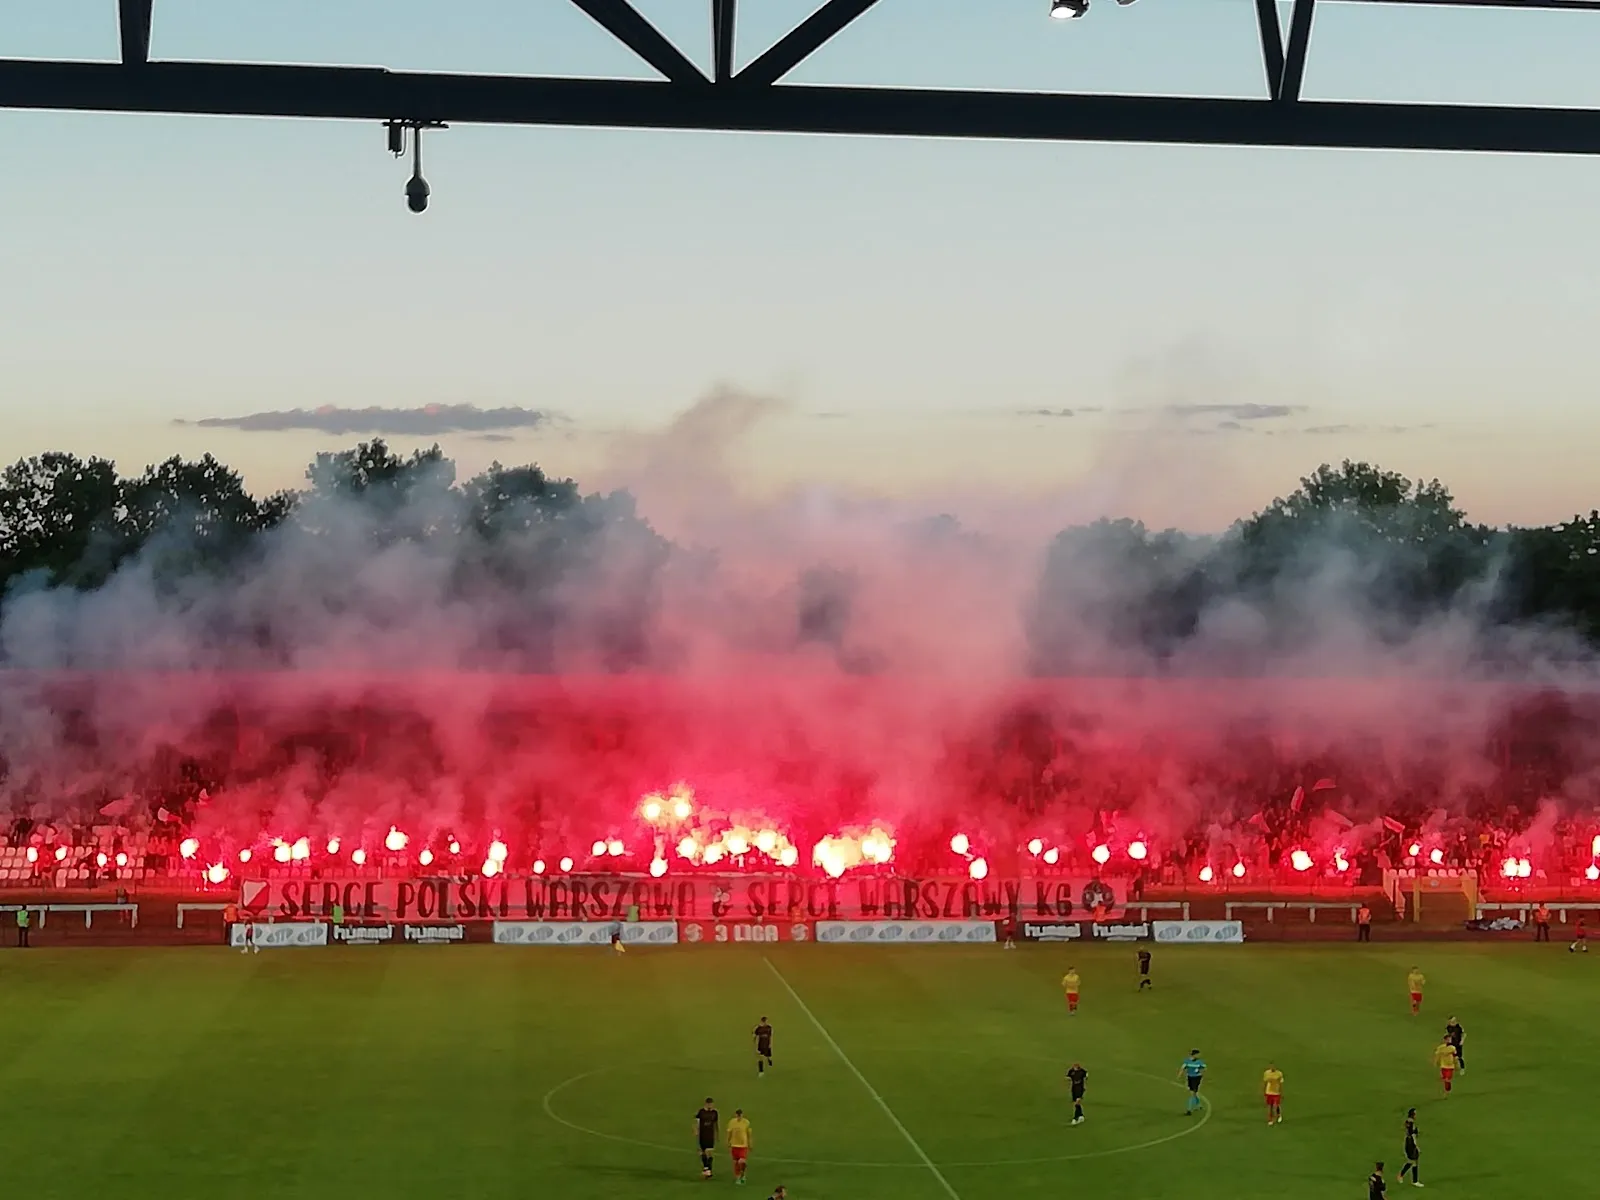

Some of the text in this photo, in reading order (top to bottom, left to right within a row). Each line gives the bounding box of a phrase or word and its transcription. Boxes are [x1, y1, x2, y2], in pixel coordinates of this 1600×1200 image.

[279, 880, 384, 918] SERCE
[525, 878, 697, 918] WARSZAWA
[858, 879, 1021, 919] WARSZAWY
[714, 924, 729, 942] 3
[733, 924, 779, 942] LIGA
